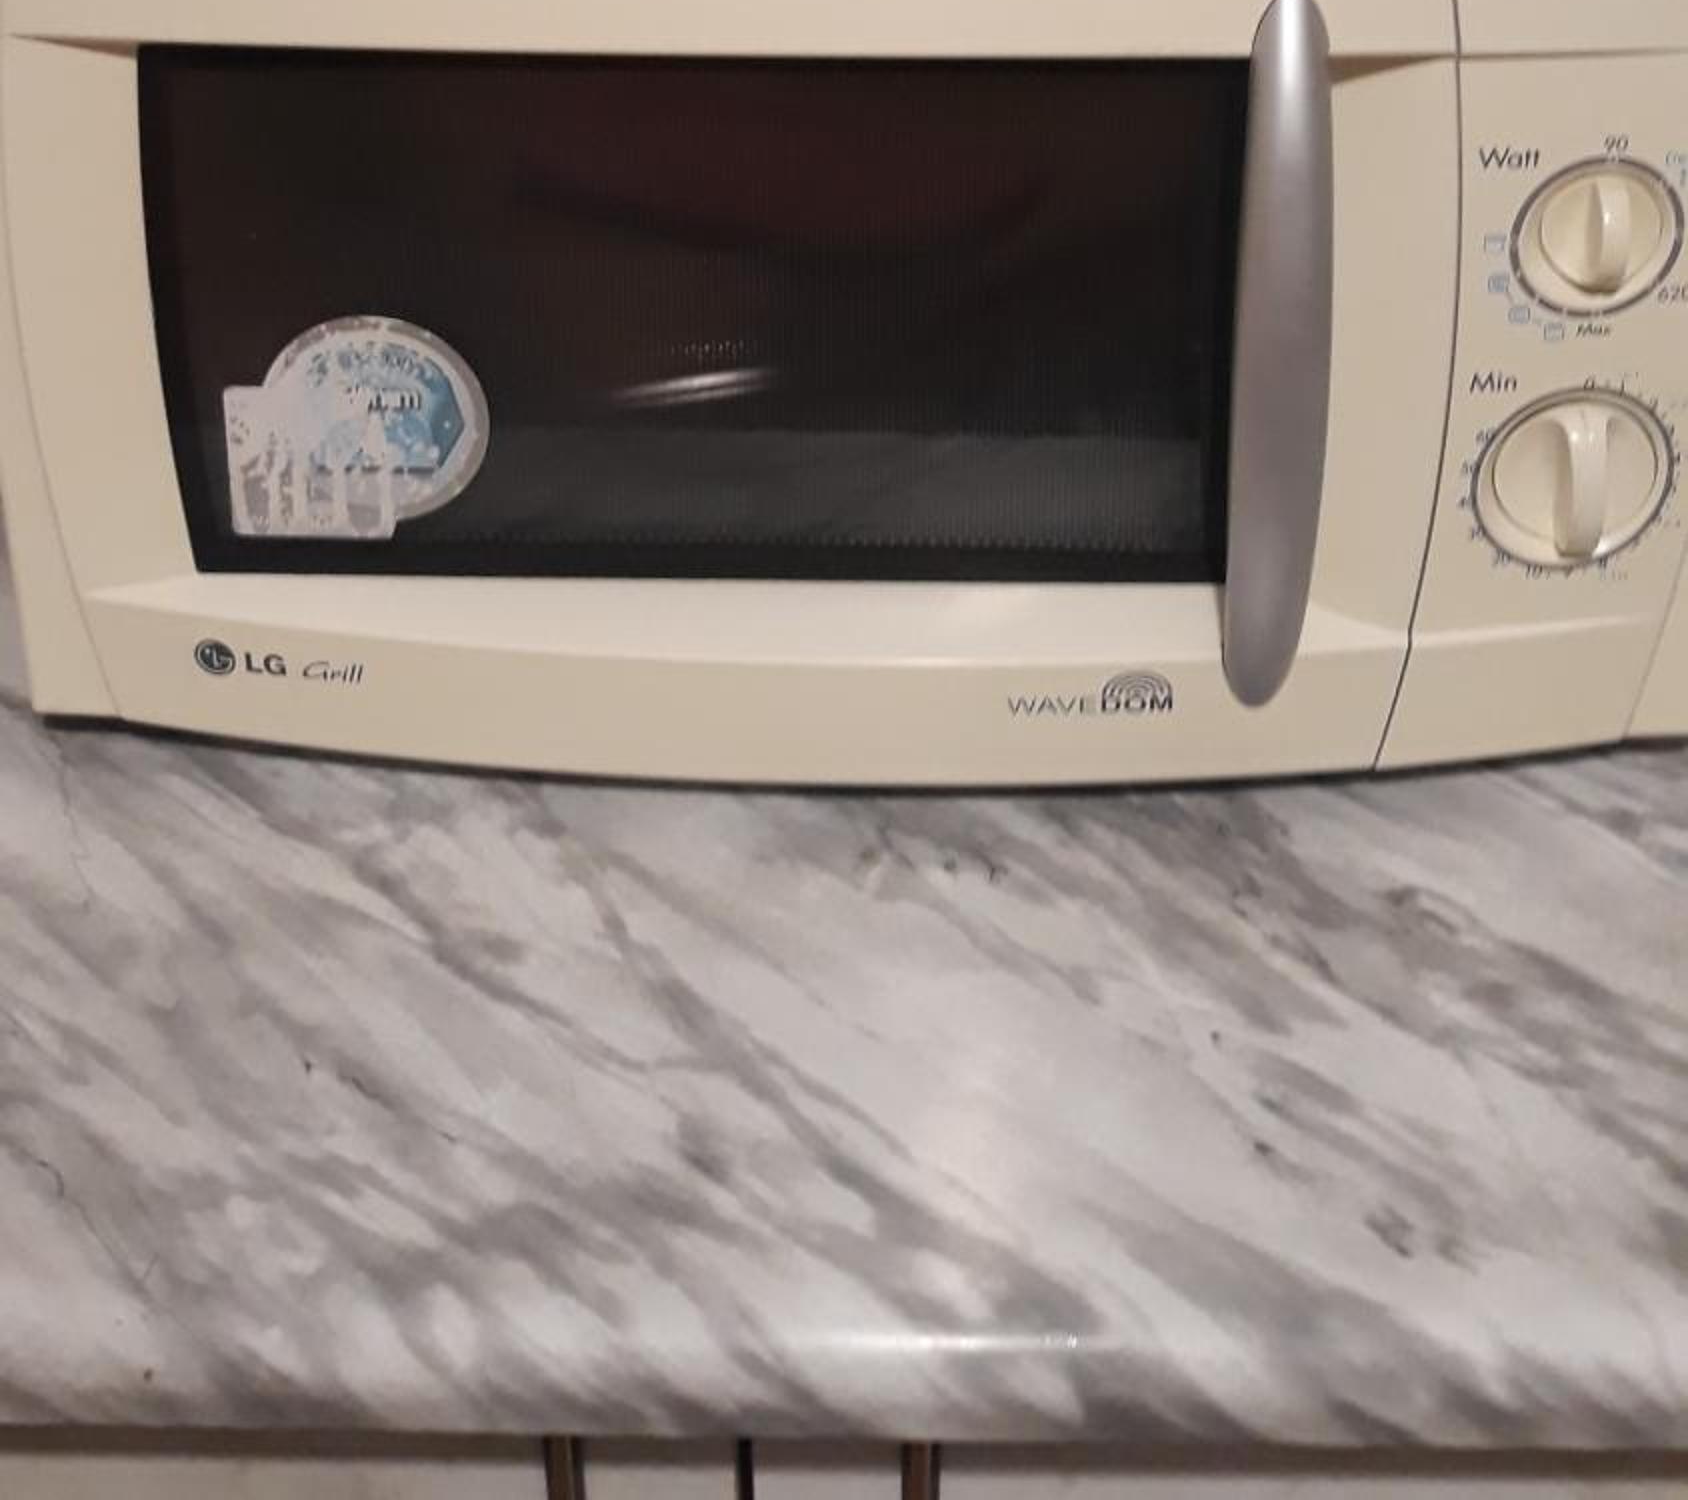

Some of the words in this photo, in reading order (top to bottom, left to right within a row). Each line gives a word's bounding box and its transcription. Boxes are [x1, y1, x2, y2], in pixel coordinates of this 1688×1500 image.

[1479, 147, 1540, 169] Watt
[1469, 372, 1518, 393] Min
[244, 652, 287, 676] LG
[302, 660, 364, 684] Grill
